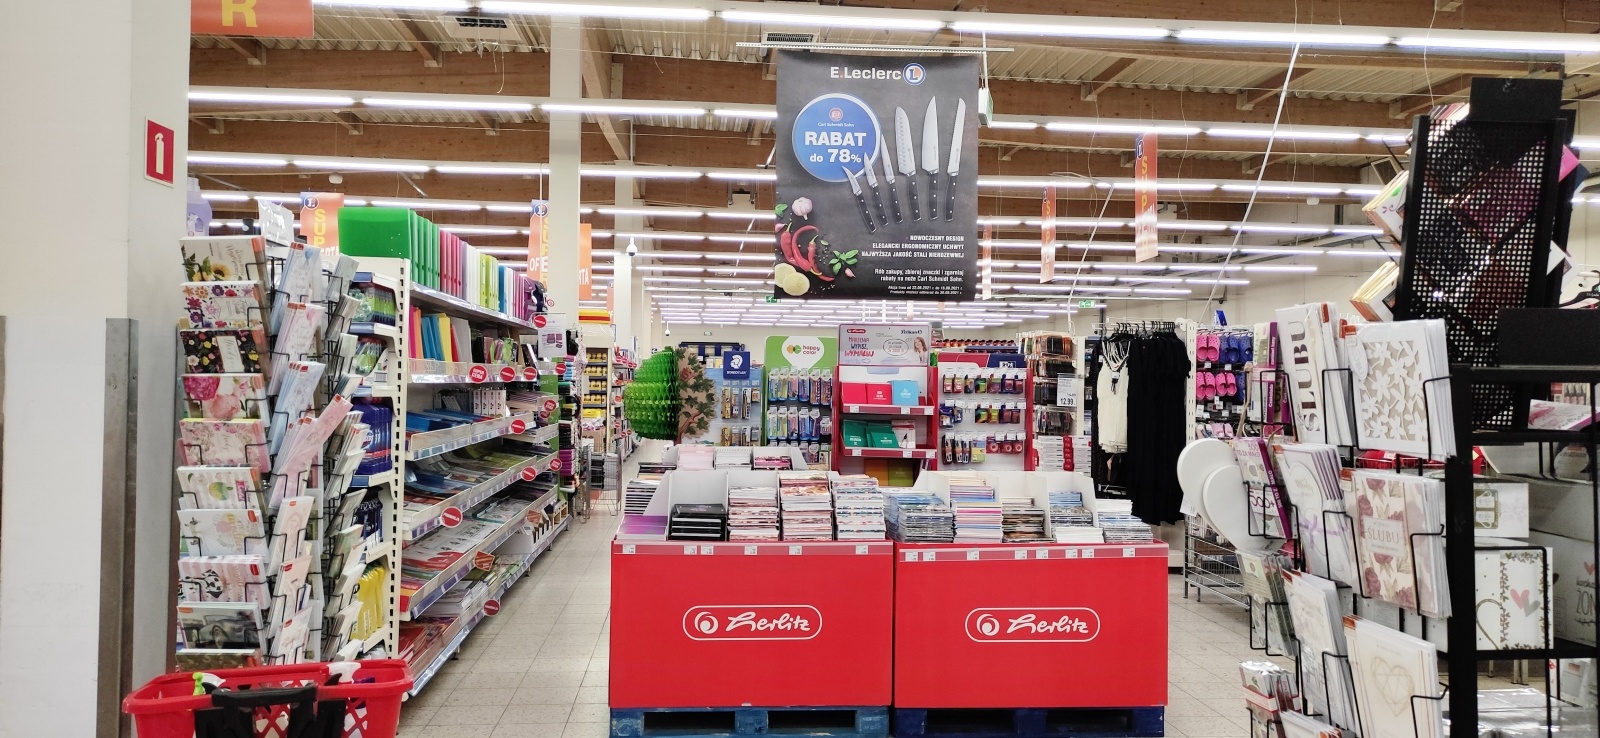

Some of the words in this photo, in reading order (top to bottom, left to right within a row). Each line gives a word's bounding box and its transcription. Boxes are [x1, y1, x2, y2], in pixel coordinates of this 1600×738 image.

[830, 66, 902, 80] E.Leclerc
[805, 131, 866, 146] RABAT
[810, 154, 823, 162] do
[828, 149, 861, 163] 78%
